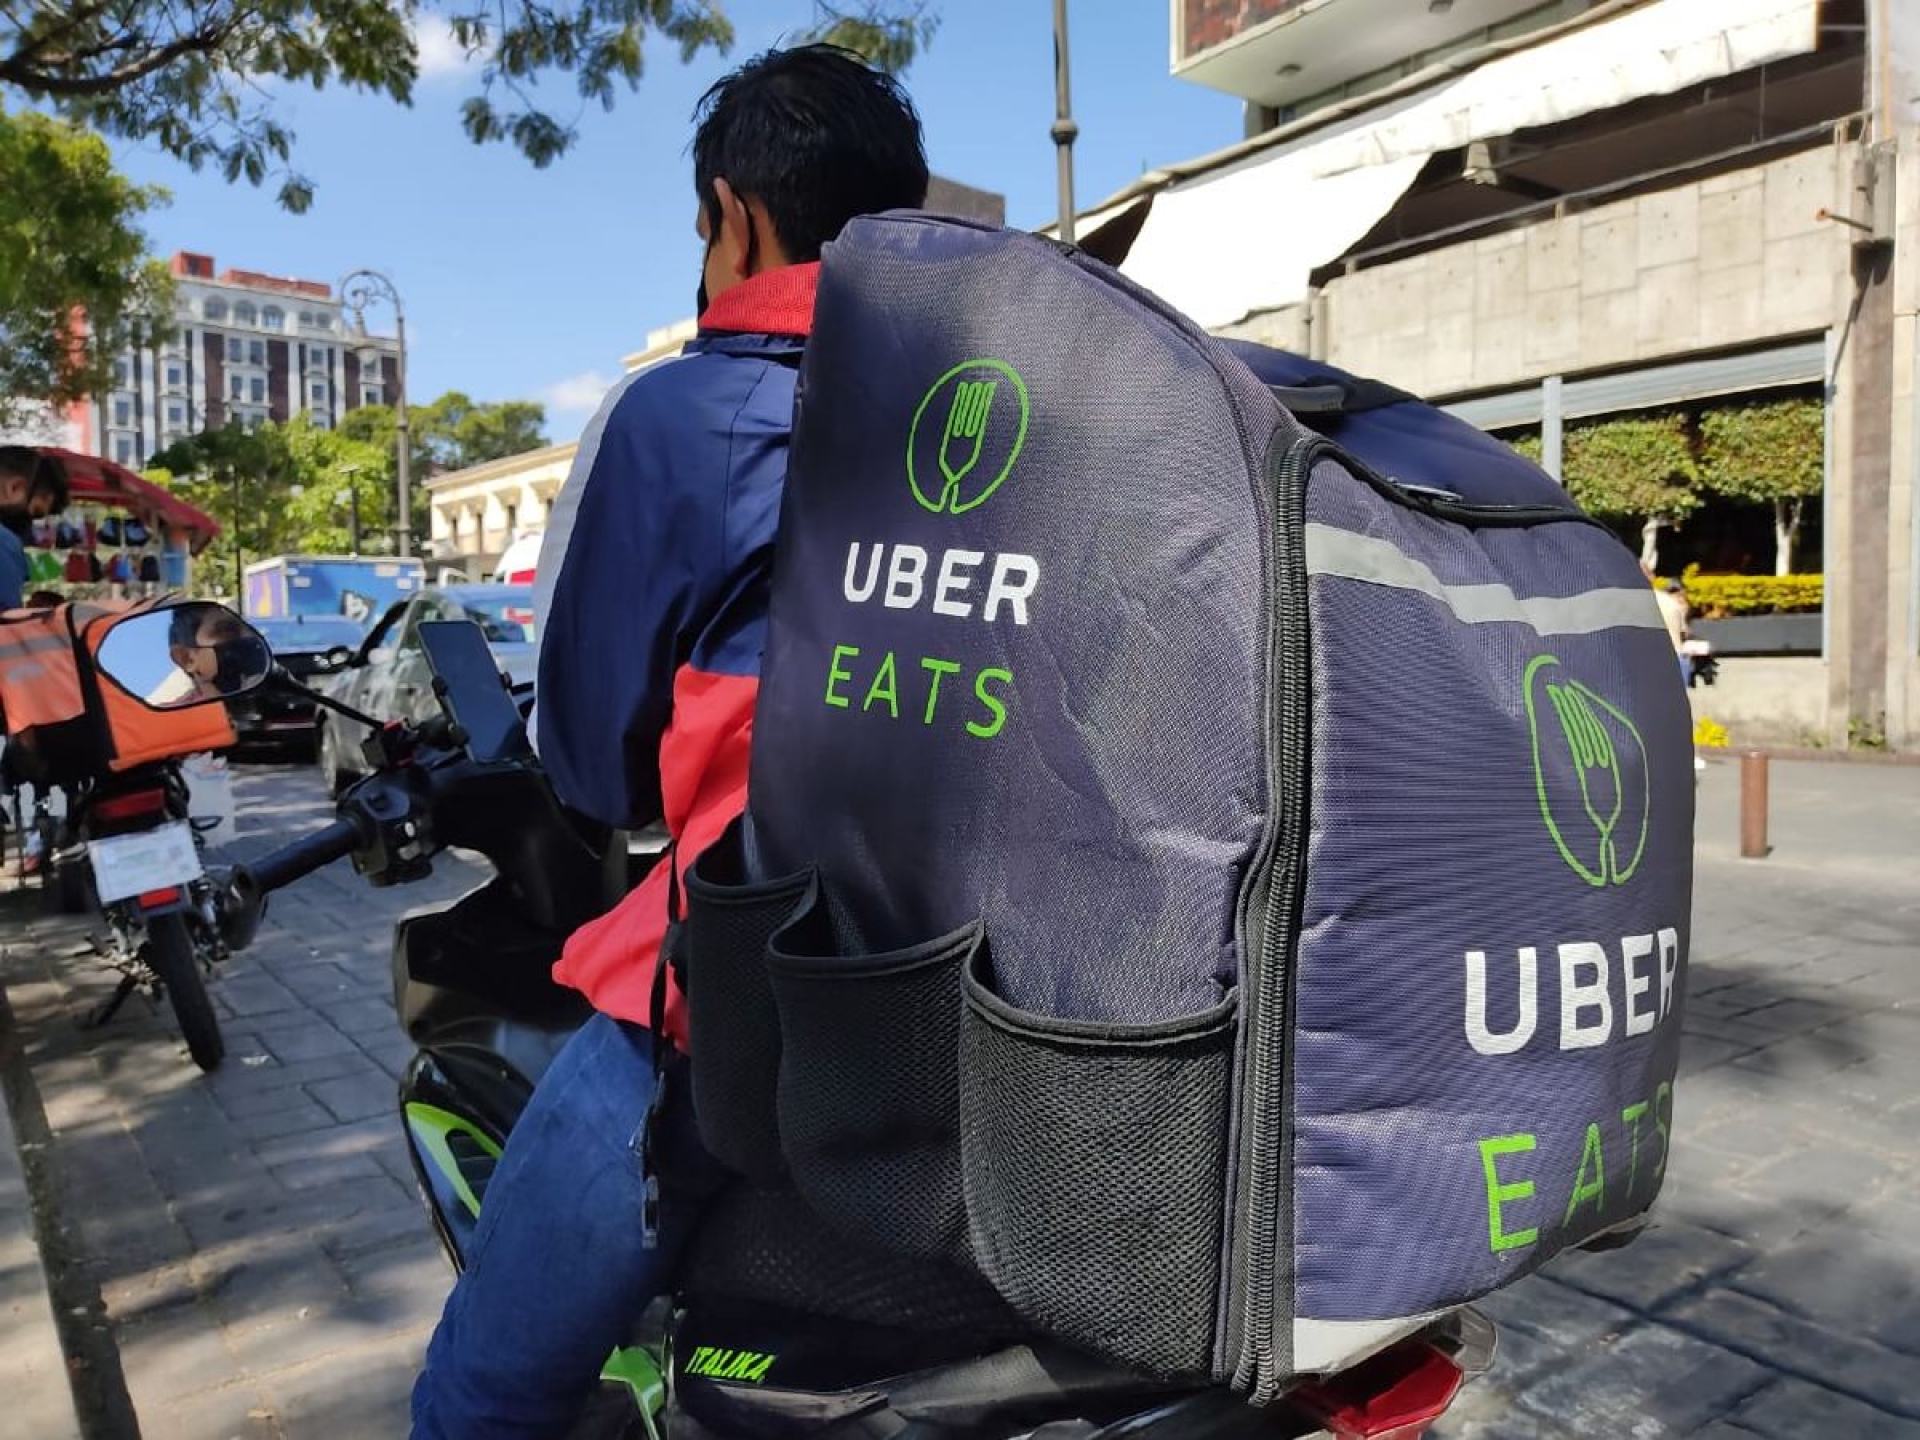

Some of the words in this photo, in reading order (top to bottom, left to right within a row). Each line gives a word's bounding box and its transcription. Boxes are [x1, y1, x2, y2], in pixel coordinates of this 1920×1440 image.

[844, 542, 1040, 625] UBER
[825, 645, 1014, 738] EATS
[1464, 927, 1679, 1056] UBER
[1477, 1081, 1672, 1254] EATS
[684, 1346, 776, 1381] ITALIKA
